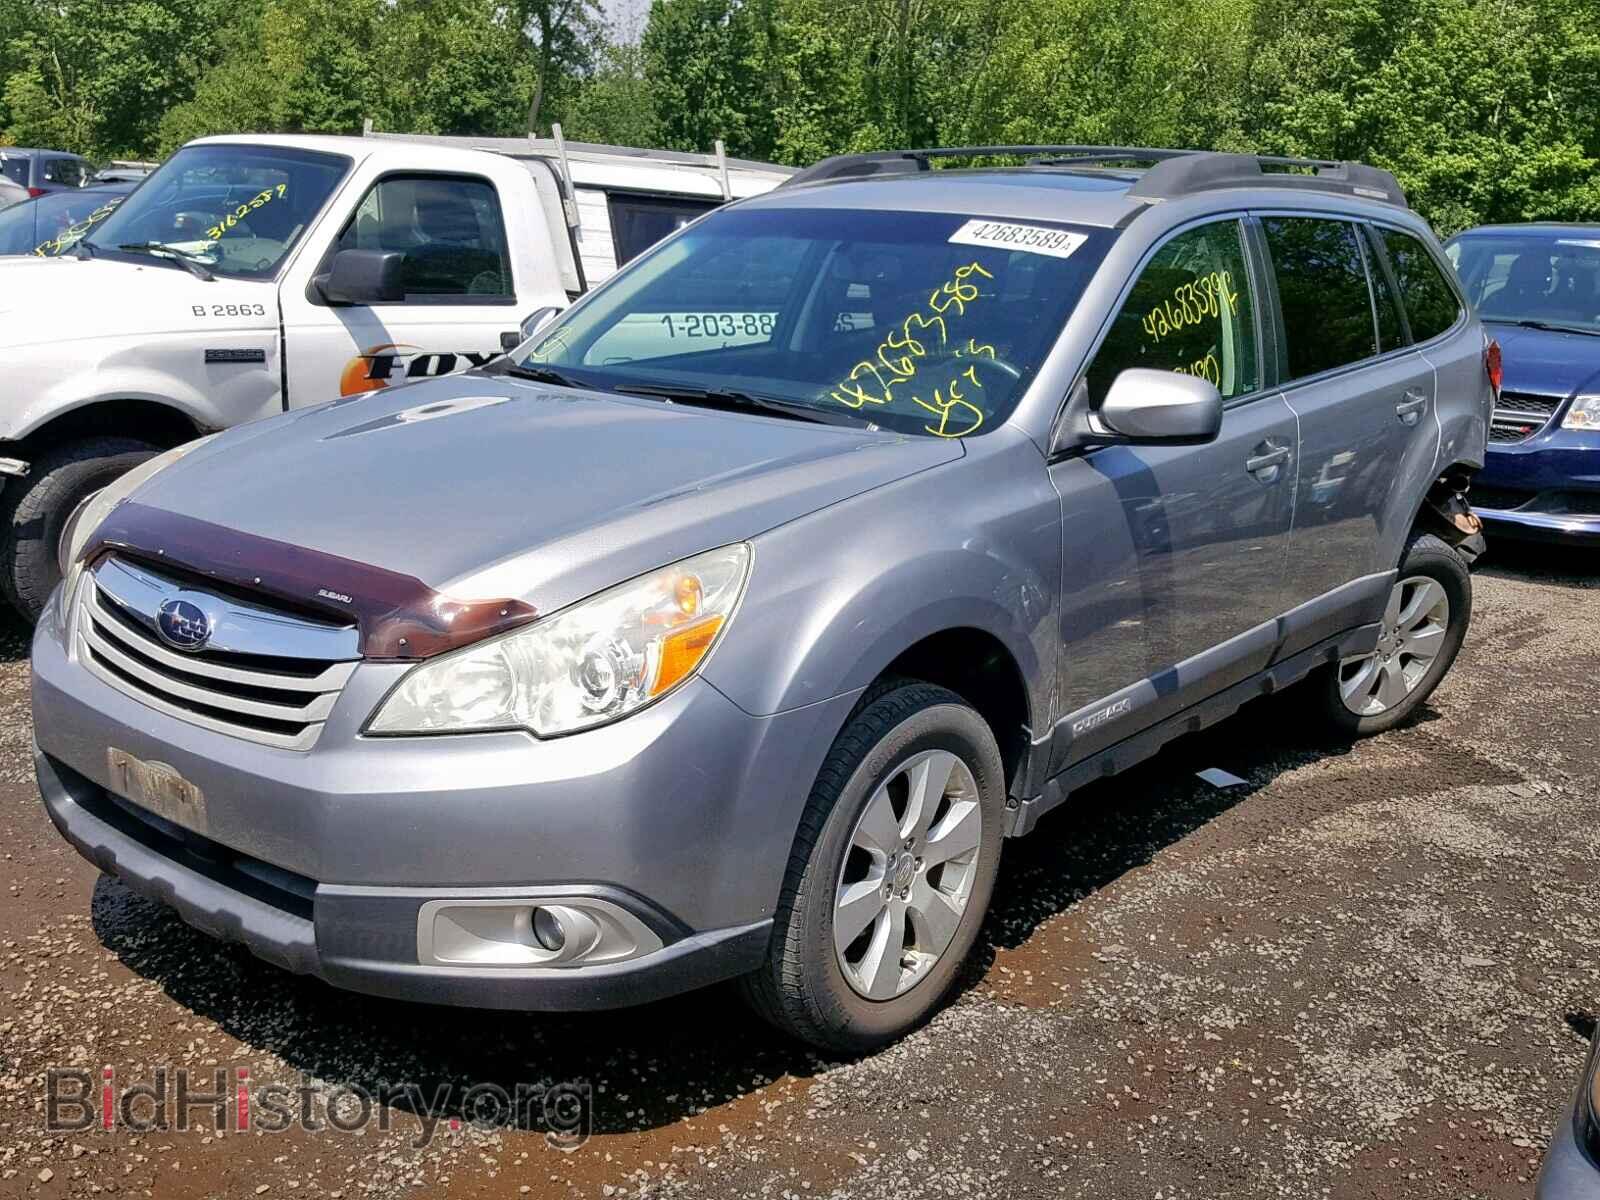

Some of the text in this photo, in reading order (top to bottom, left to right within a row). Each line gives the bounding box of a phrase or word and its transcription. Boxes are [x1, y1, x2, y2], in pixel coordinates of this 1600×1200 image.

[192, 303, 265, 317] B 2863
[832, 262, 994, 408] 42683589
